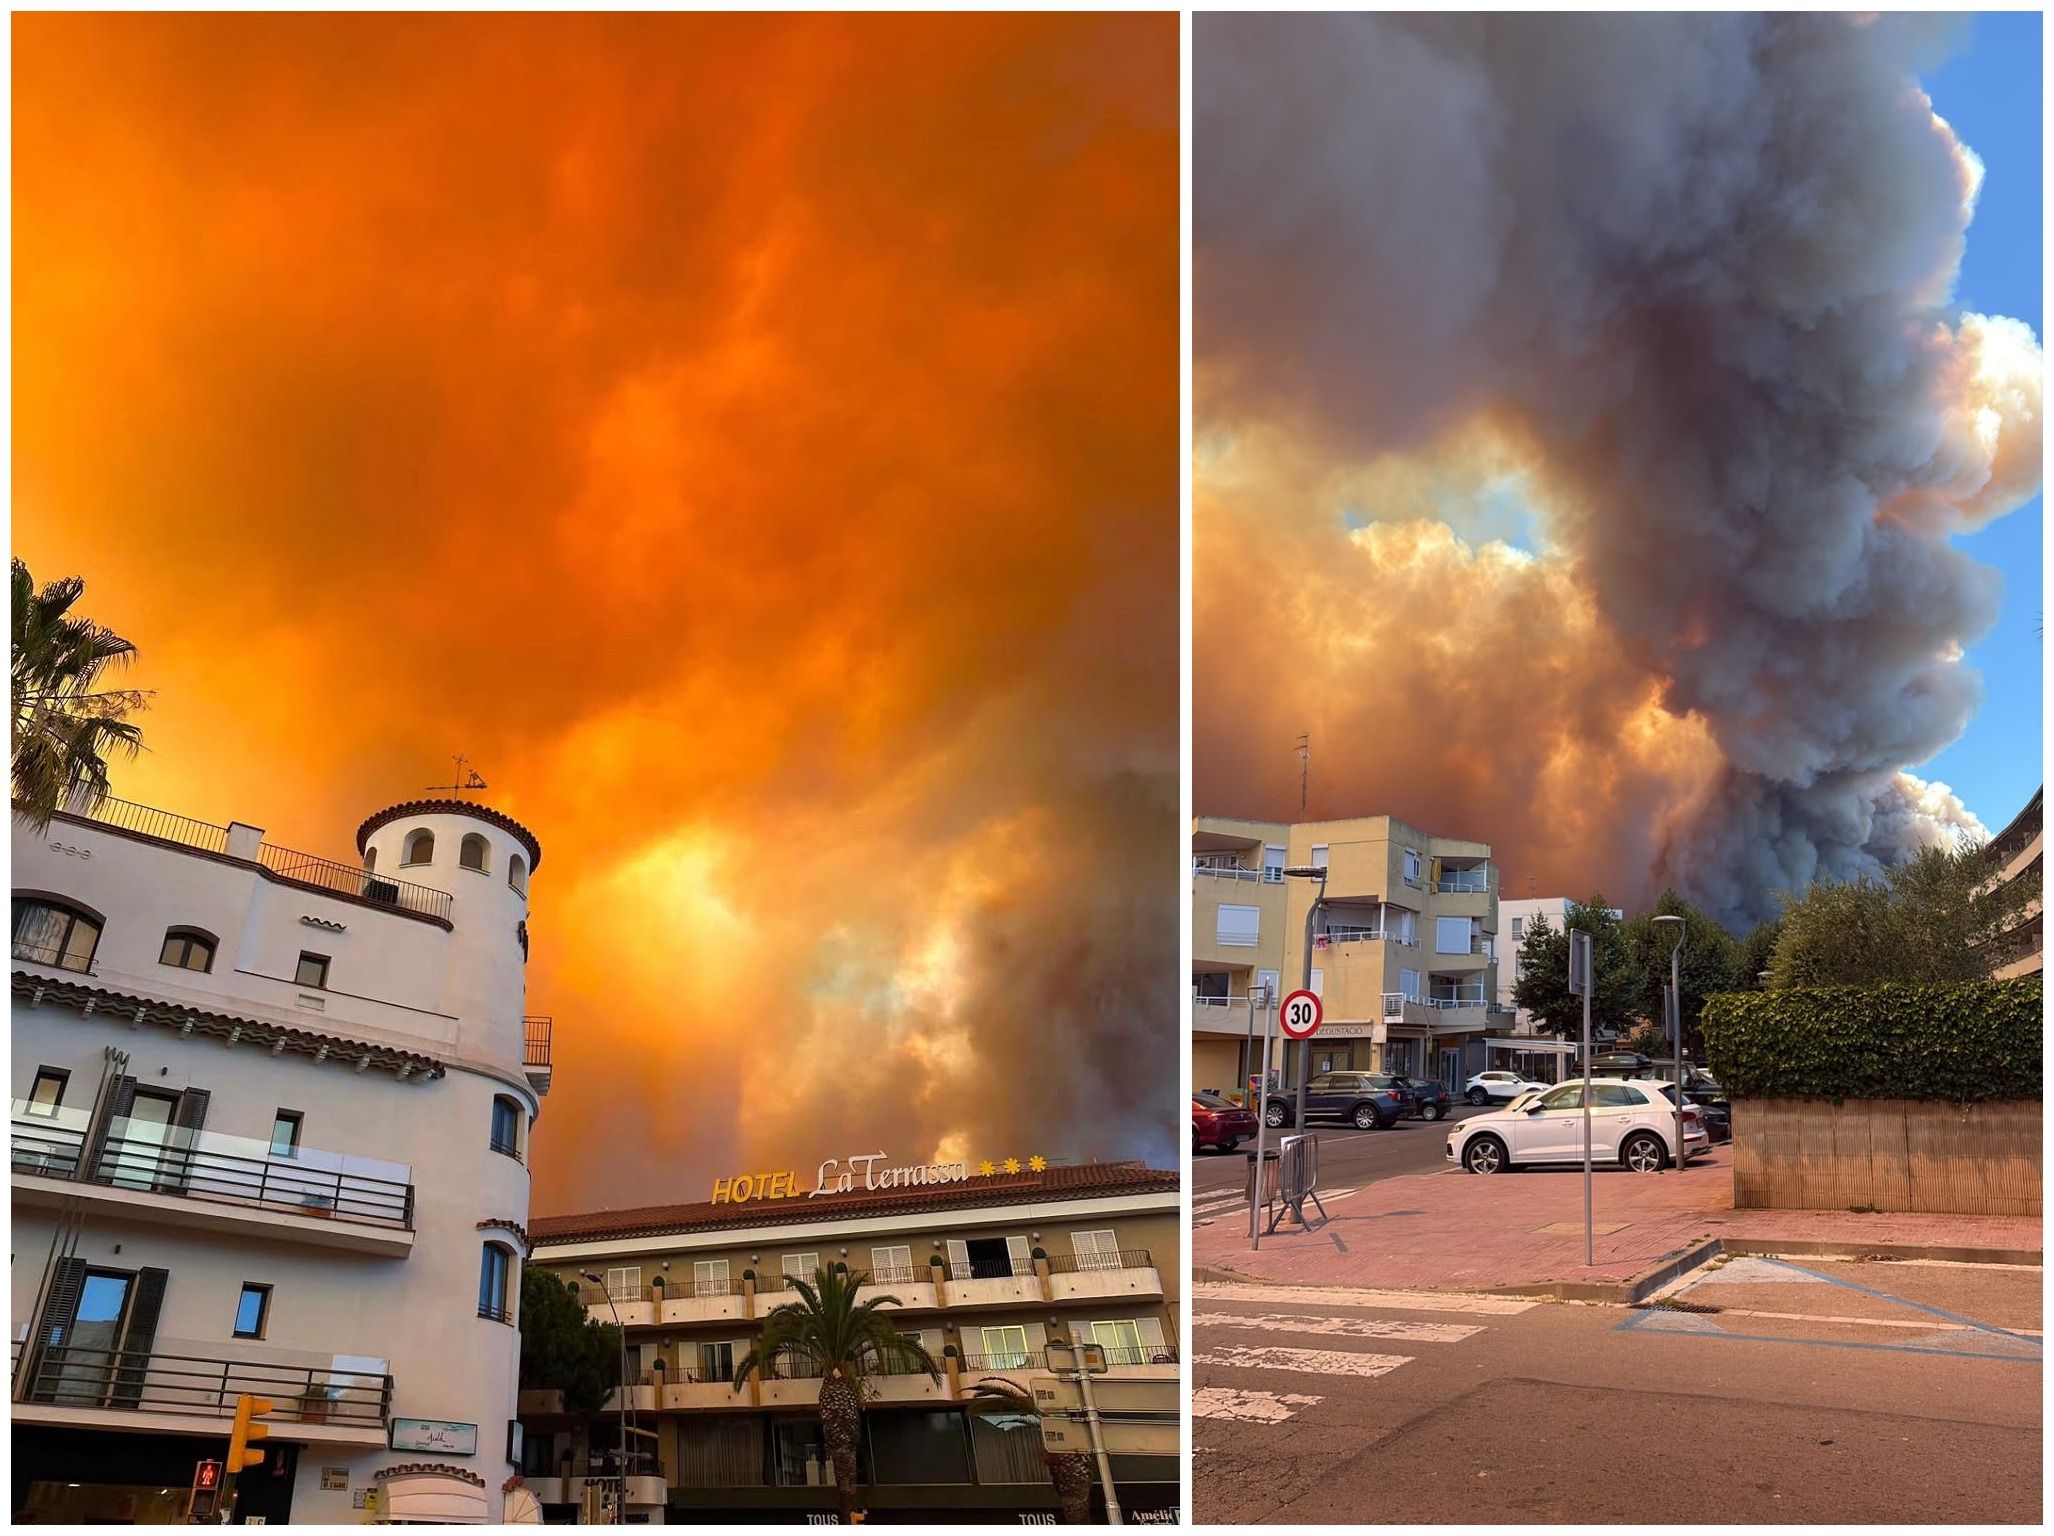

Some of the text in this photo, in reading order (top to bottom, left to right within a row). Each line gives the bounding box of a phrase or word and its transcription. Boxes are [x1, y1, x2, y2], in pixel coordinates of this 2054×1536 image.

[1290, 1003, 1312, 1024] 30
[711, 1150, 969, 1205] HOTEL La Terrassa
[806, 1514, 839, 1525] TOUS
[1019, 1514, 1056, 1525] TOUS
